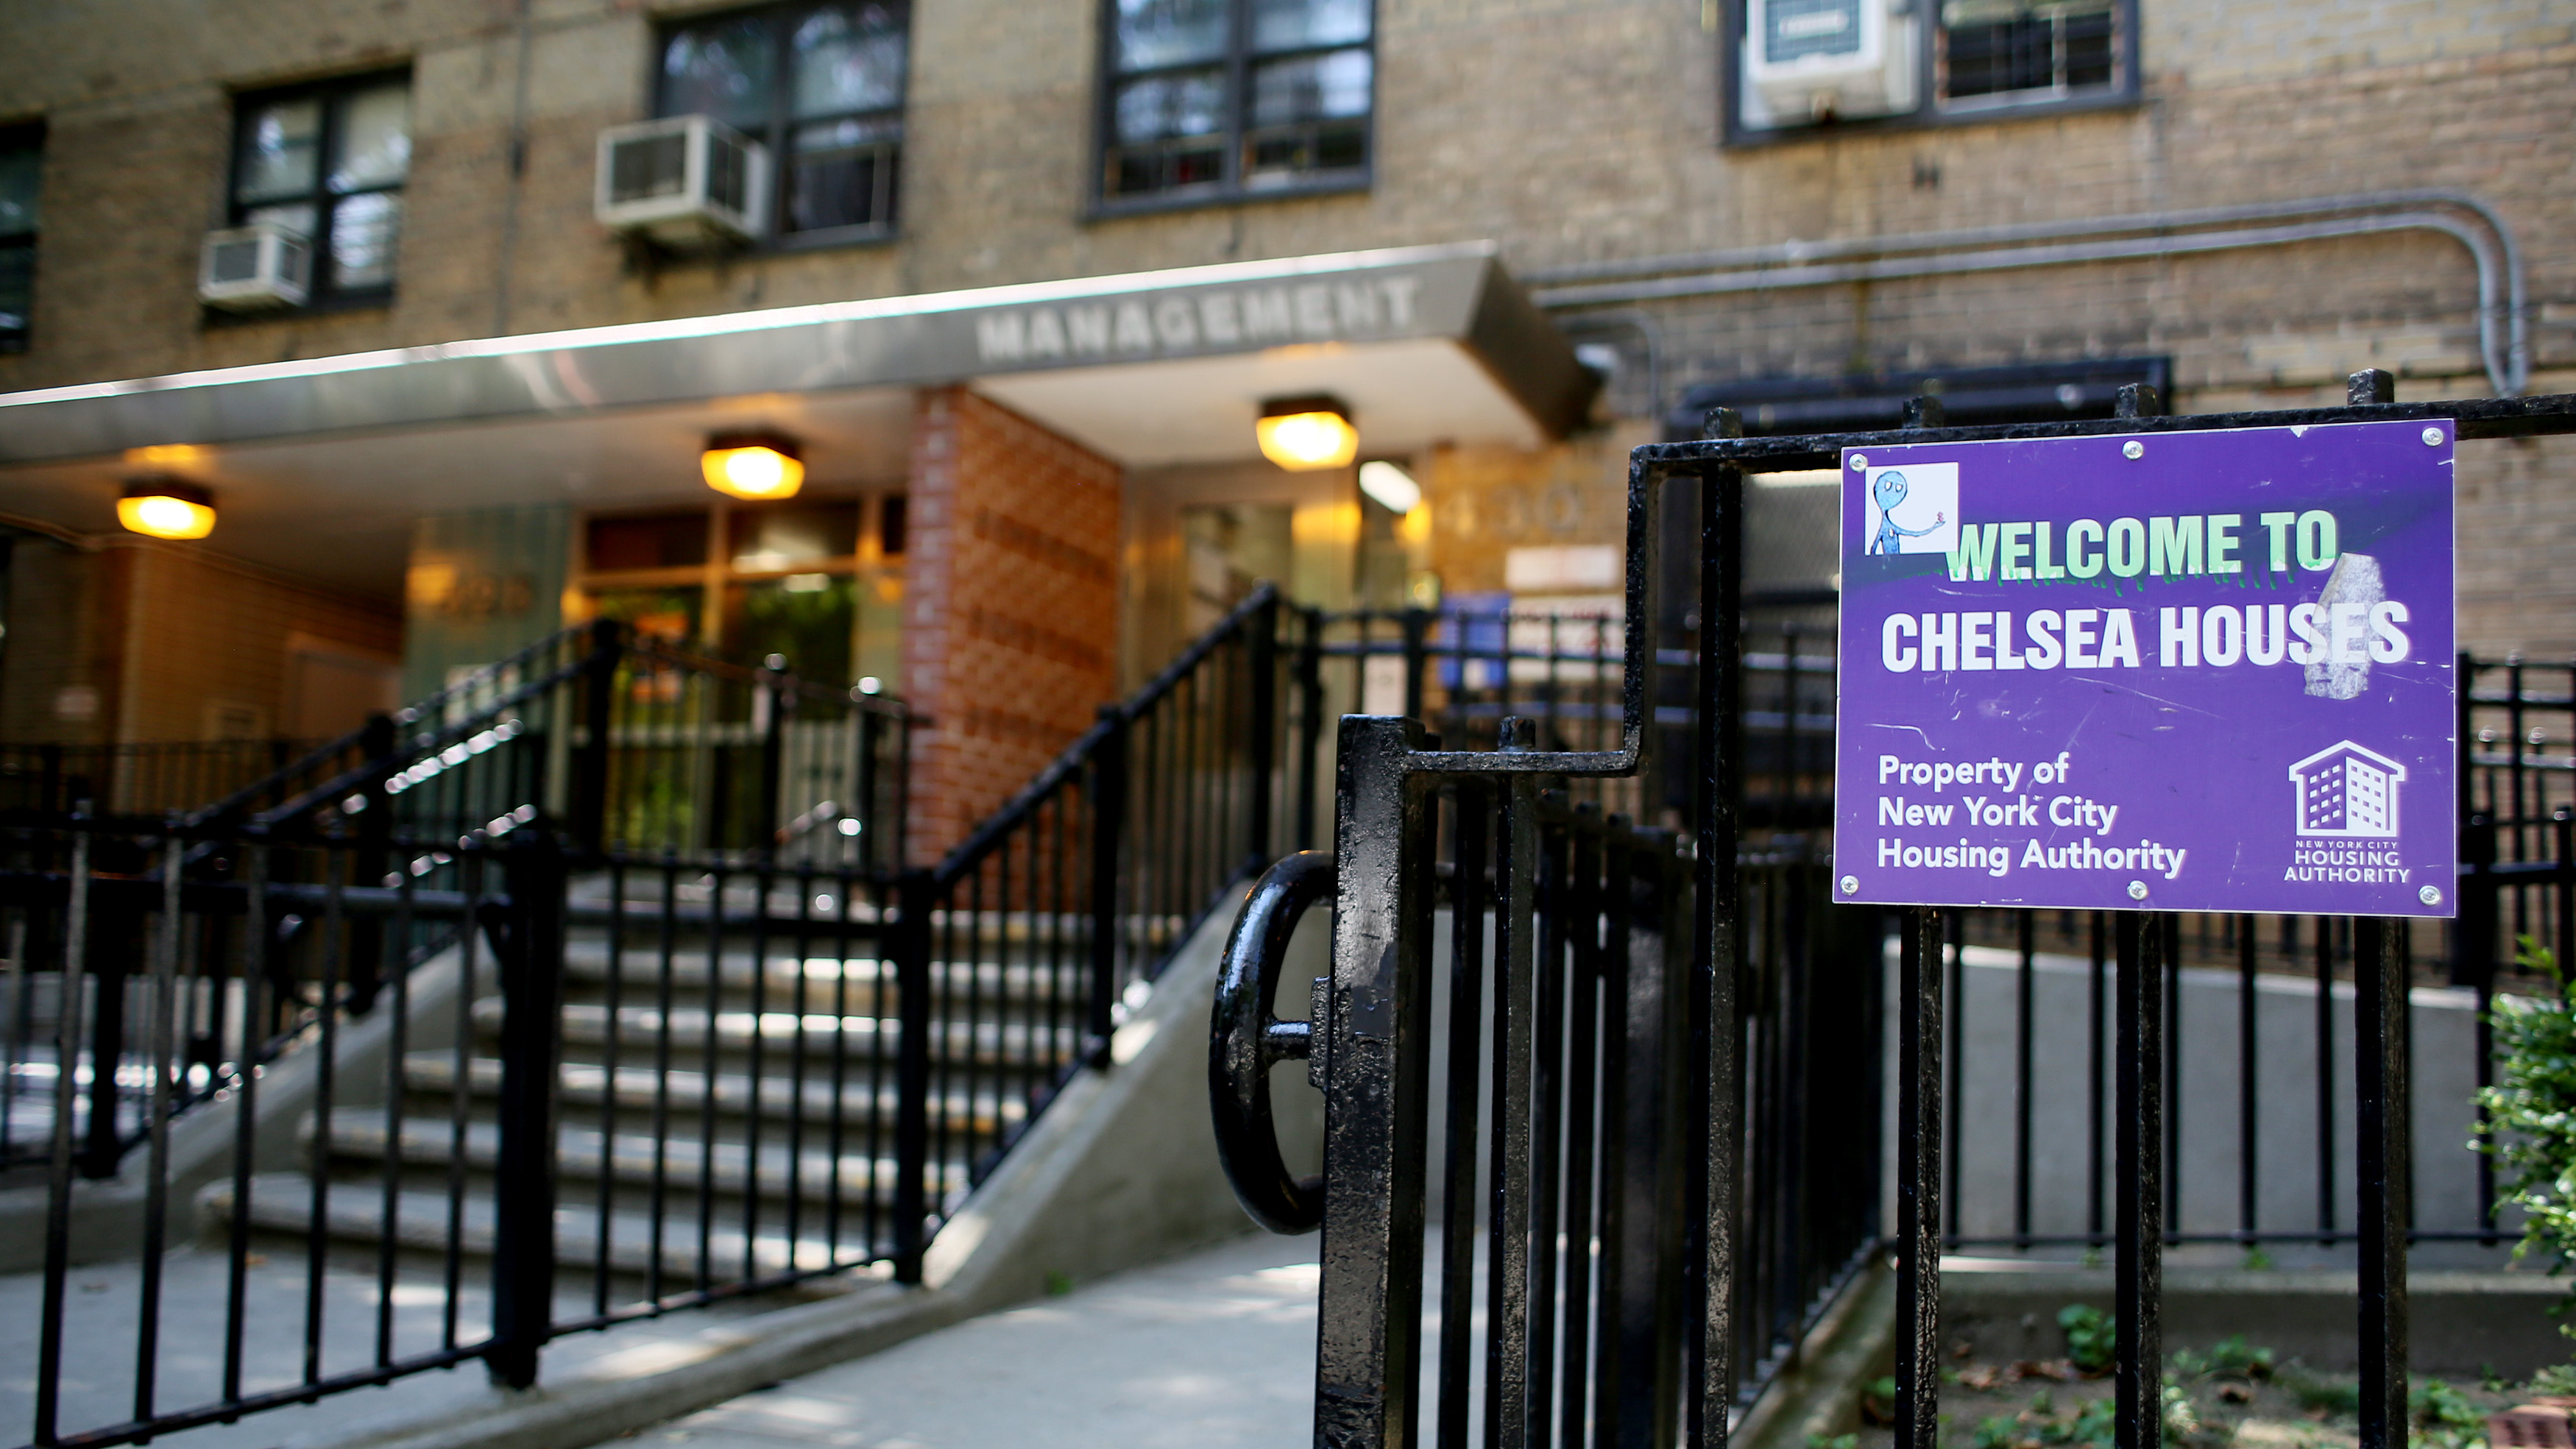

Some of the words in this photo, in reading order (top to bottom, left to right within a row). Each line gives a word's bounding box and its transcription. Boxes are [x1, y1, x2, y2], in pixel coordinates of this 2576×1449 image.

[976, 277, 1419, 361] MANAGEMENT
[1945, 514, 2242, 582] WELCOME
[2260, 510, 2337, 572] TO
[1880, 607, 2140, 673] CHELSEA
[2159, 600, 2410, 668] HOUSES
[1879, 755, 2023, 793] Property
[2033, 751, 2069, 784] of
[1878, 796, 1954, 826] New
[1962, 794, 2039, 826] York
[2048, 795, 2118, 837] City
[1878, 837, 2009, 878] Housing
[2020, 837, 2187, 880] Authority
[2294, 849, 2399, 866] HOUSING
[2296, 840, 2324, 848] NEW
[2328, 840, 2363, 849] YORK
[2367, 841, 2398, 849] CITY
[2284, 867, 2410, 883] AUTHORITY
